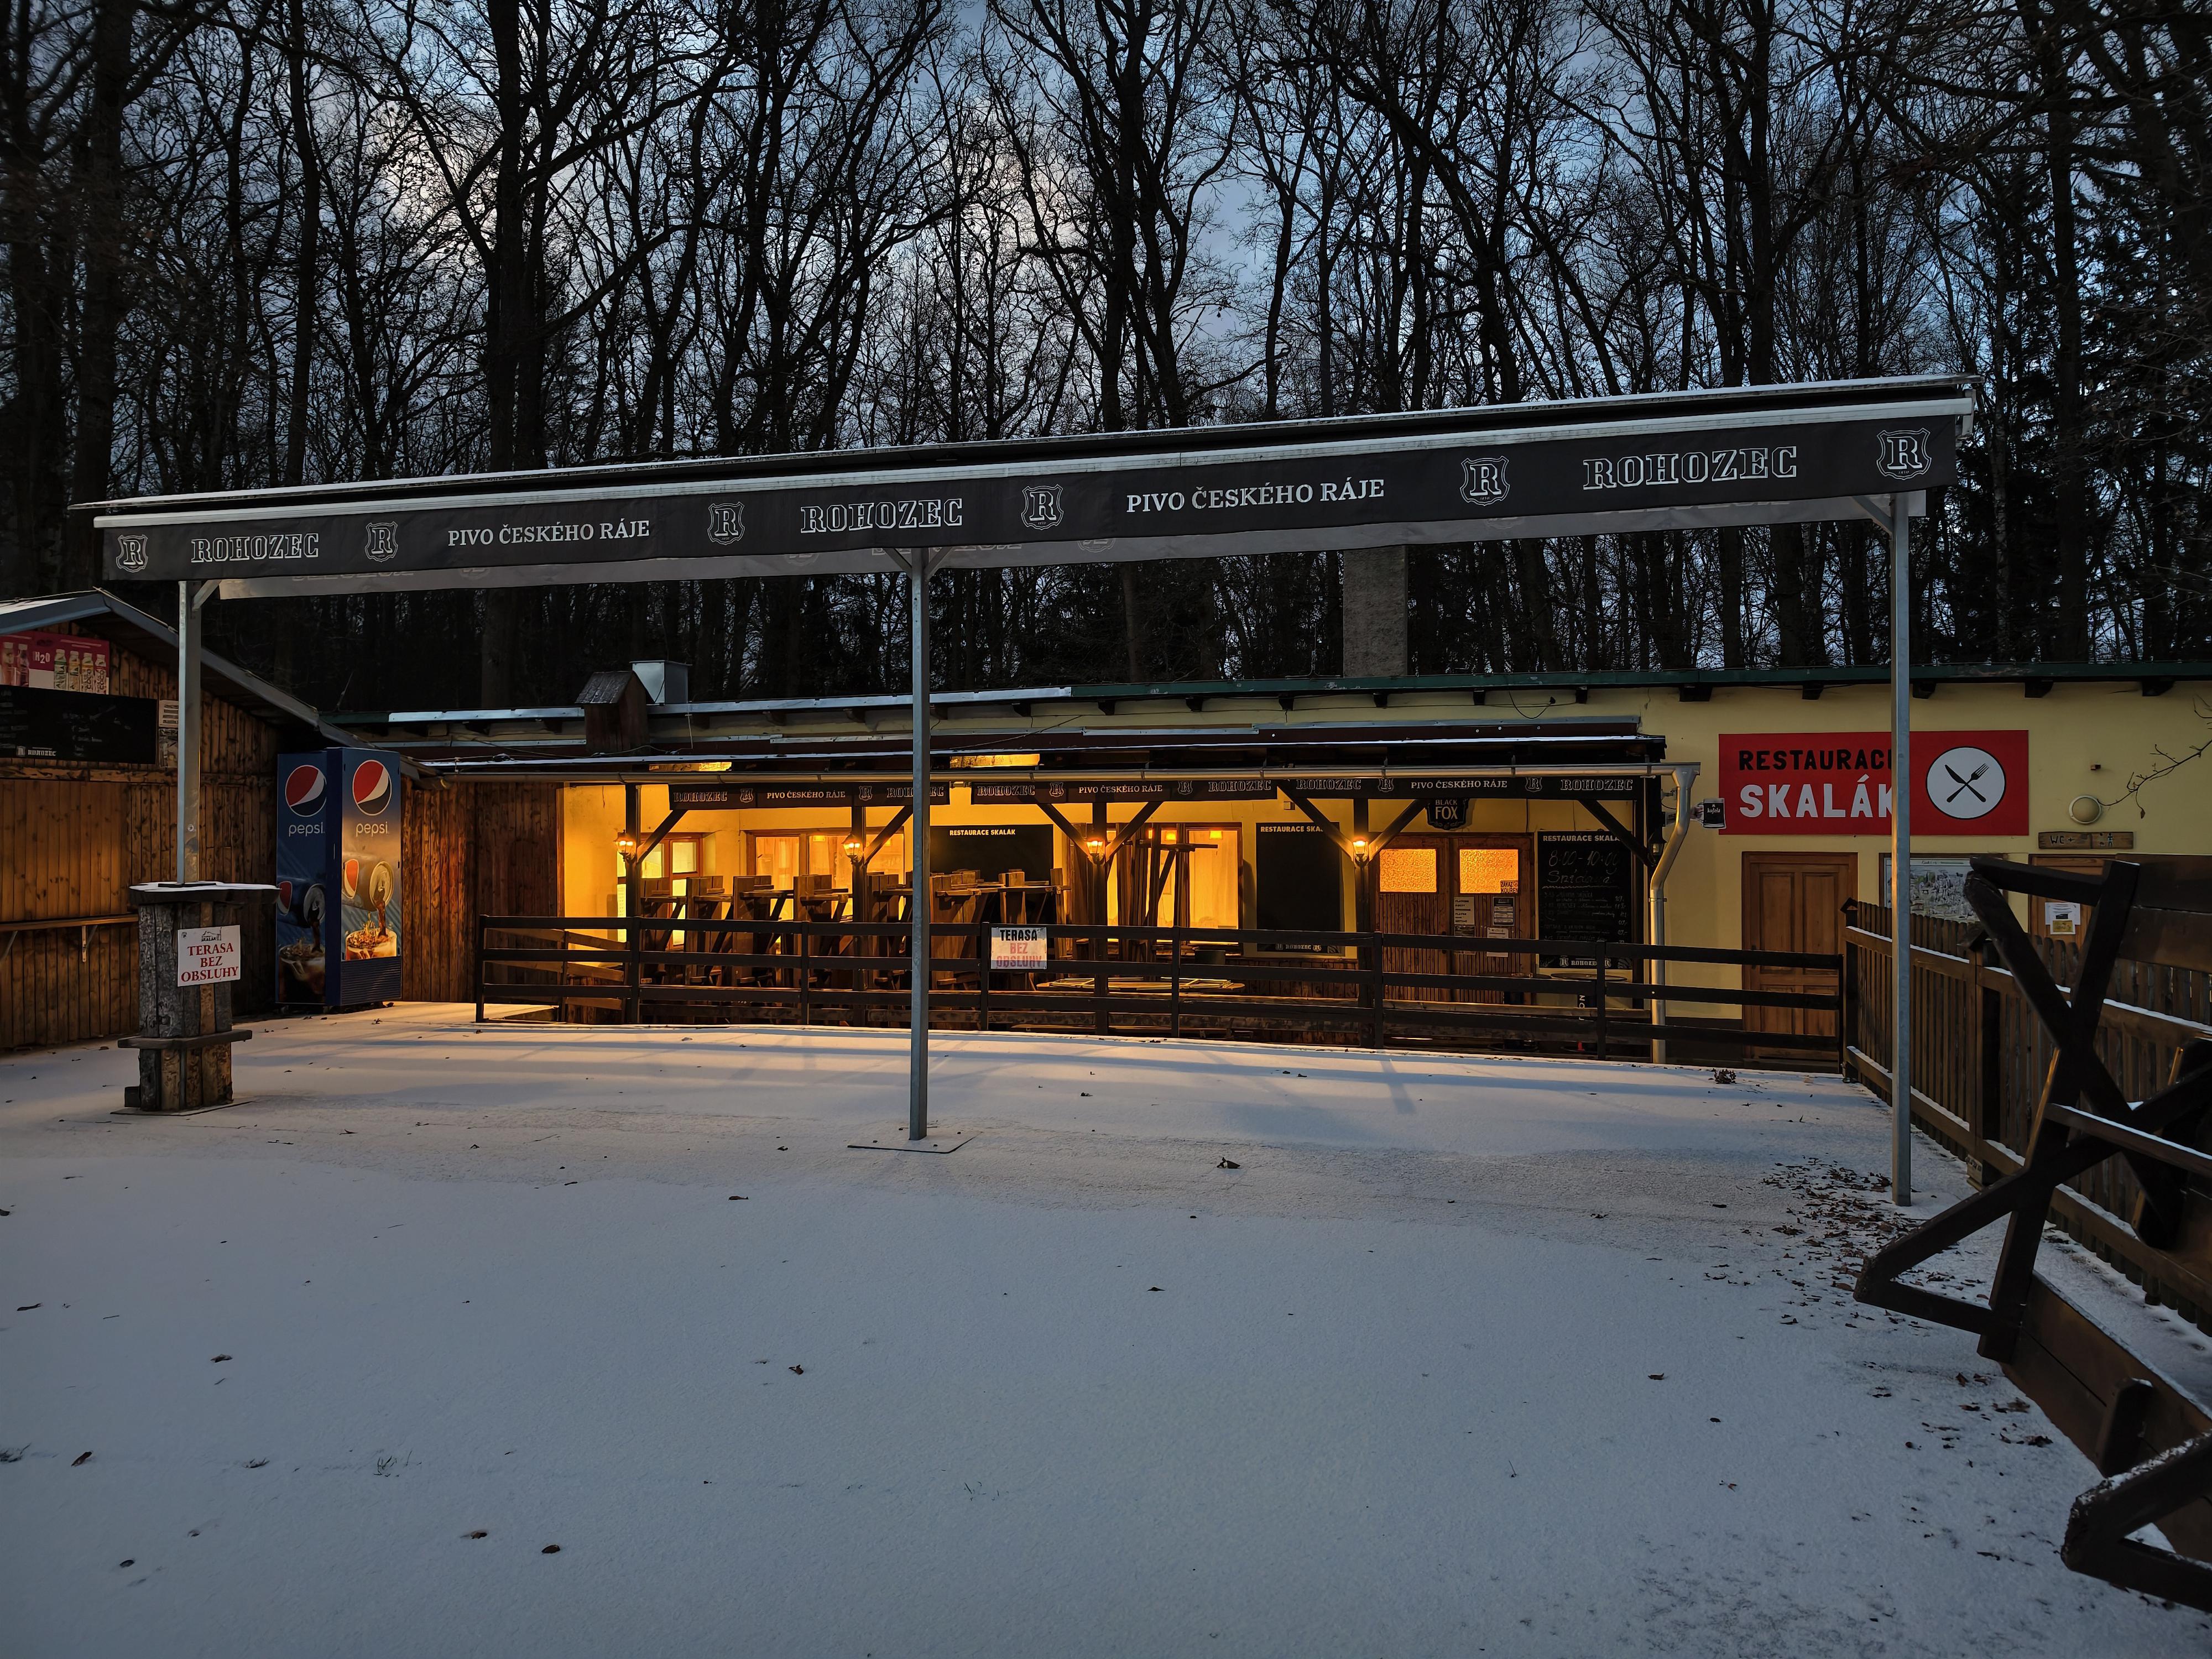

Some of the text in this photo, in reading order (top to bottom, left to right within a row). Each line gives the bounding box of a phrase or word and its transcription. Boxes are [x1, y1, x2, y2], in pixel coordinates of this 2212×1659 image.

[1583, 446, 1797, 490] ROHOZEC
[1126, 476, 1384, 513] PIVO ČESKÉHO RÁJE
[800, 498, 962, 533] ROHOZEC
[447, 518, 650, 546] PIVO ČESKÉHO RÁJE
[191, 533, 319, 563] ROHOZEC
[1100, 784, 1140, 794] ČESKÉHO
[1141, 784, 1163, 792] RÁJE
[1208, 780, 1271, 792] ROHOZEC
[1296, 779, 1361, 790] ROHOZEC
[1436, 779, 1481, 789] ČESKÉHO
[1484, 779, 1507, 788] RÁJE
[1560, 779, 1633, 790] ROHOZEC
[673, 791, 728, 802] ROHOZEC
[787, 790, 824, 799] ČESKÉHO
[826, 789, 846, 799] RÁJE
[886, 786, 944, 798] ROHEC
[977, 785, 1035, 796] ROHOZEC
[1739, 774, 1892, 818] SKALÁK
[1435, 806, 1458, 820] FOX
[289, 821, 324, 837] pepsi
[356, 821, 388, 837] pepsi
[2050, 836, 2064, 844] WC
[1000, 930, 1037, 941] TERASA
[187, 943, 233, 956] TERASA
[1010, 942, 1028, 954] BEZ
[200, 956, 222, 967] BEZ
[181, 966, 239, 982] OBSLUHY
